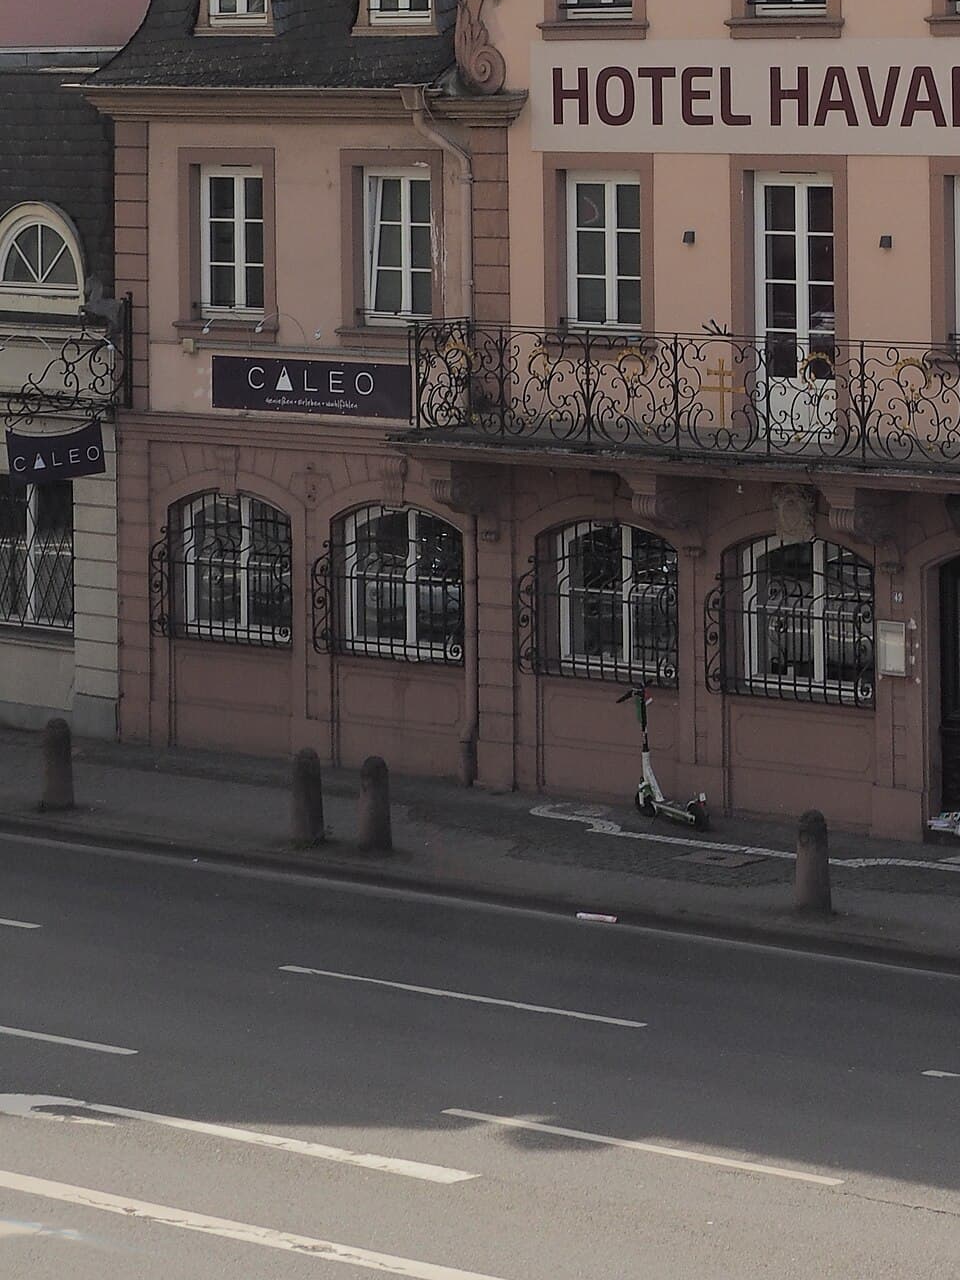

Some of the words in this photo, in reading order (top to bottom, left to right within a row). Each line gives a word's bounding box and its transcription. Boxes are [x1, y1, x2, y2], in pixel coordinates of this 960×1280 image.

[552, 65, 752, 127] HOTEL
[247, 365, 375, 396] CALEO
[12, 445, 101, 473] CALEO
